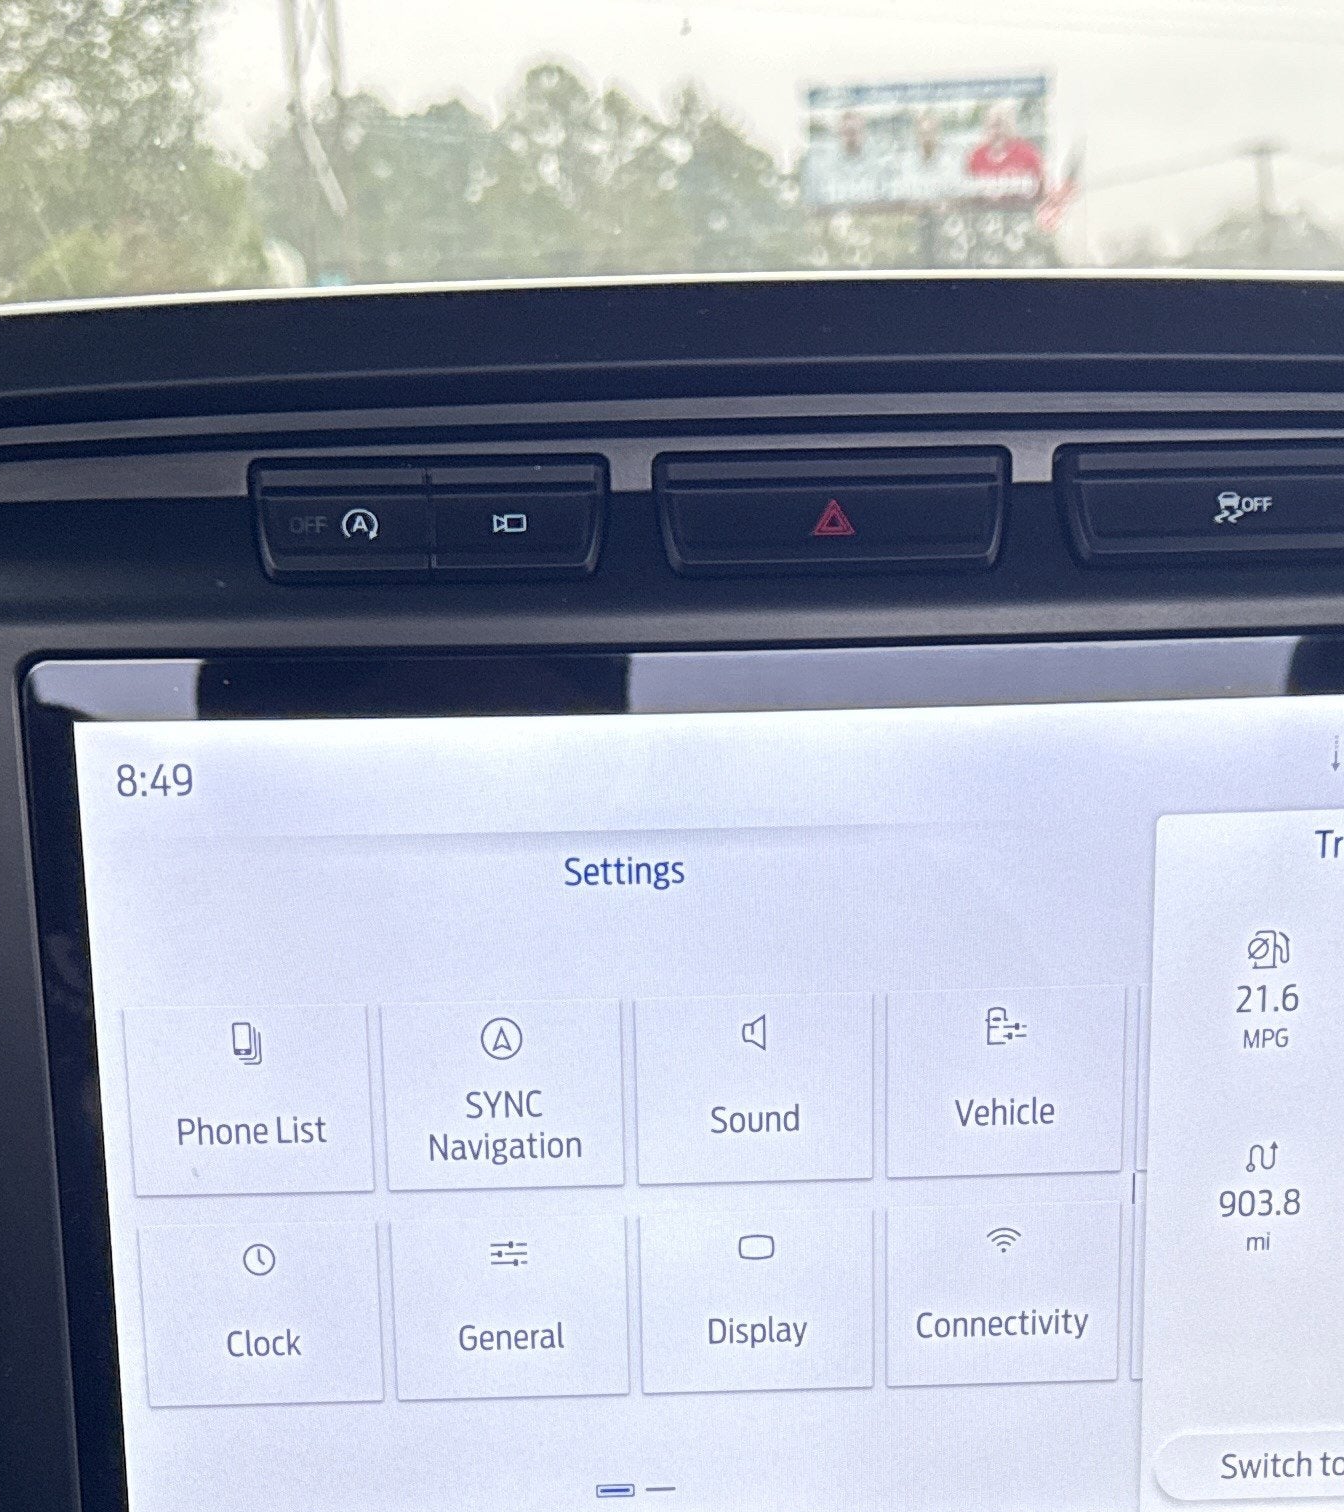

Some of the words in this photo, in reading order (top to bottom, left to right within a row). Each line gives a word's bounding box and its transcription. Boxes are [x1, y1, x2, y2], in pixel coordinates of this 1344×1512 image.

[1241, 496, 1273, 512] OFF
[117, 764, 192, 797] 8:49
[565, 857, 684, 890] Settings
[1236, 984, 1298, 1013] 21.6
[1244, 1028, 1288, 1048] MPG
[466, 1090, 542, 1119] SYNC
[711, 1104, 799, 1133] Sound
[955, 1097, 1054, 1126] Vehicle
[178, 1117, 268, 1145] Phone
[277, 1116, 327, 1143] List
[430, 1132, 581, 1165] Navigation
[1220, 1189, 1300, 1217] 903.8
[1247, 1232, 1270, 1251] mi
[459, 1322, 564, 1351] General
[709, 1316, 807, 1348] Display
[917, 1309, 1088, 1339] Connectivity
[227, 1329, 301, 1357] Clock
[1221, 1451, 1311, 1479] Switch
